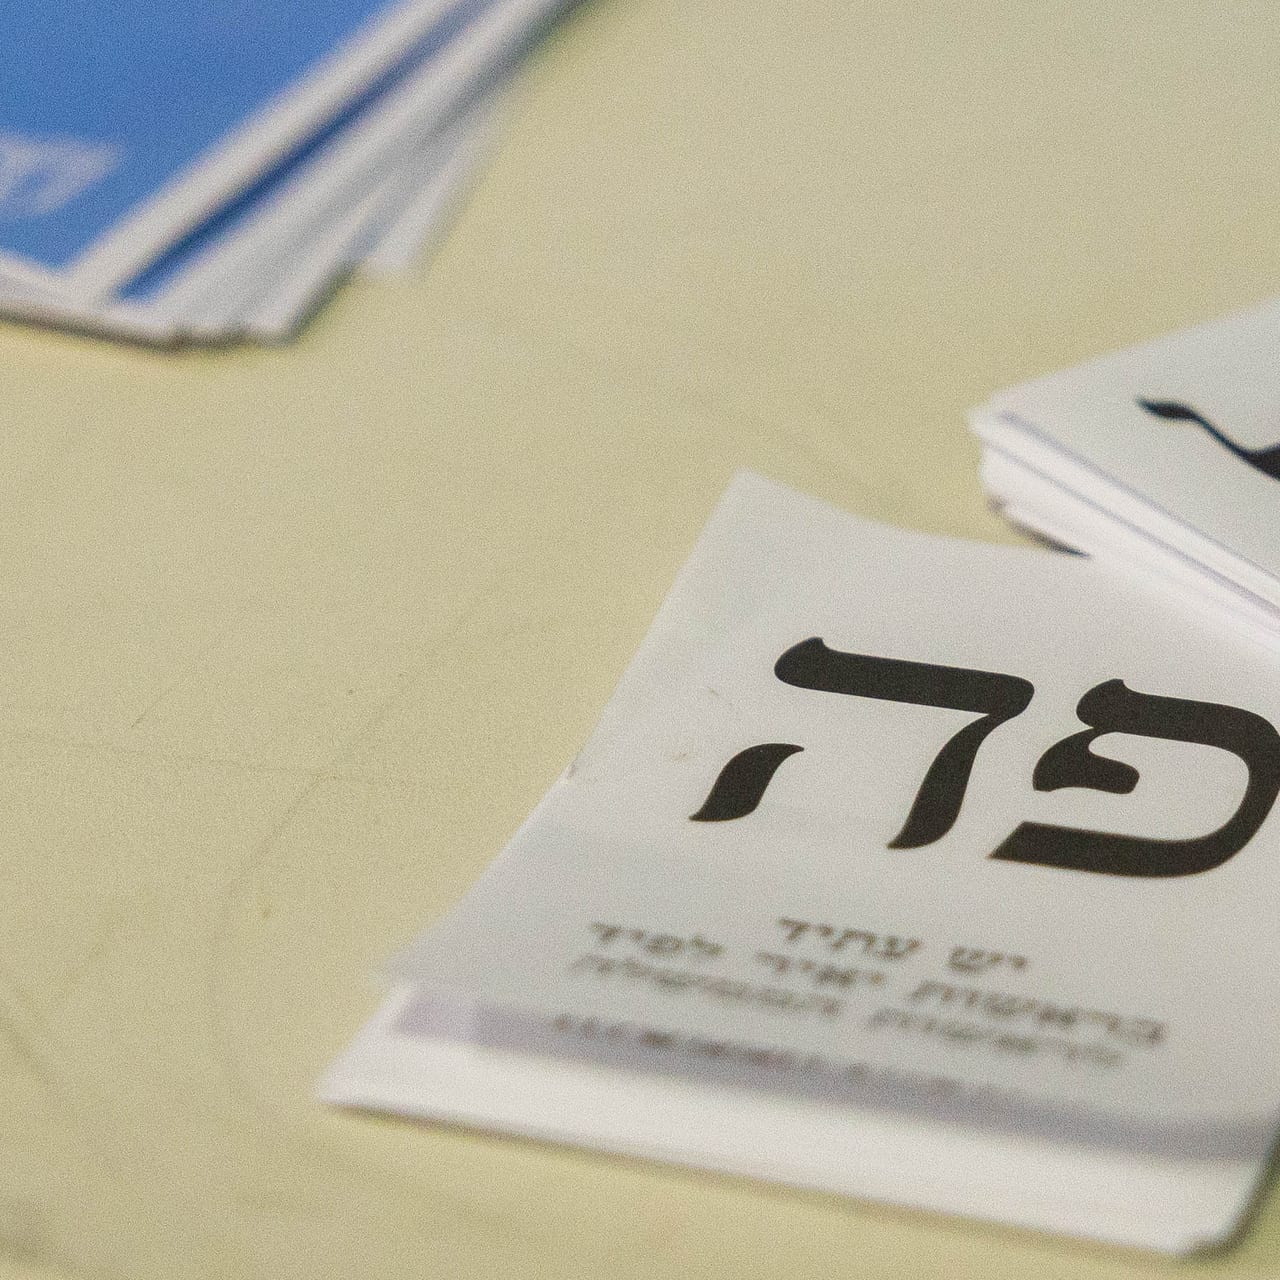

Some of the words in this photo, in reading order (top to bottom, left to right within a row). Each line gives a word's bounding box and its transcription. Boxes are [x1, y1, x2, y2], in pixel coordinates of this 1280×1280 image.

[588, 919, 726, 960] לפיד
[775, 916, 924, 963] עתיד
[946, 944, 1030, 976] יש
